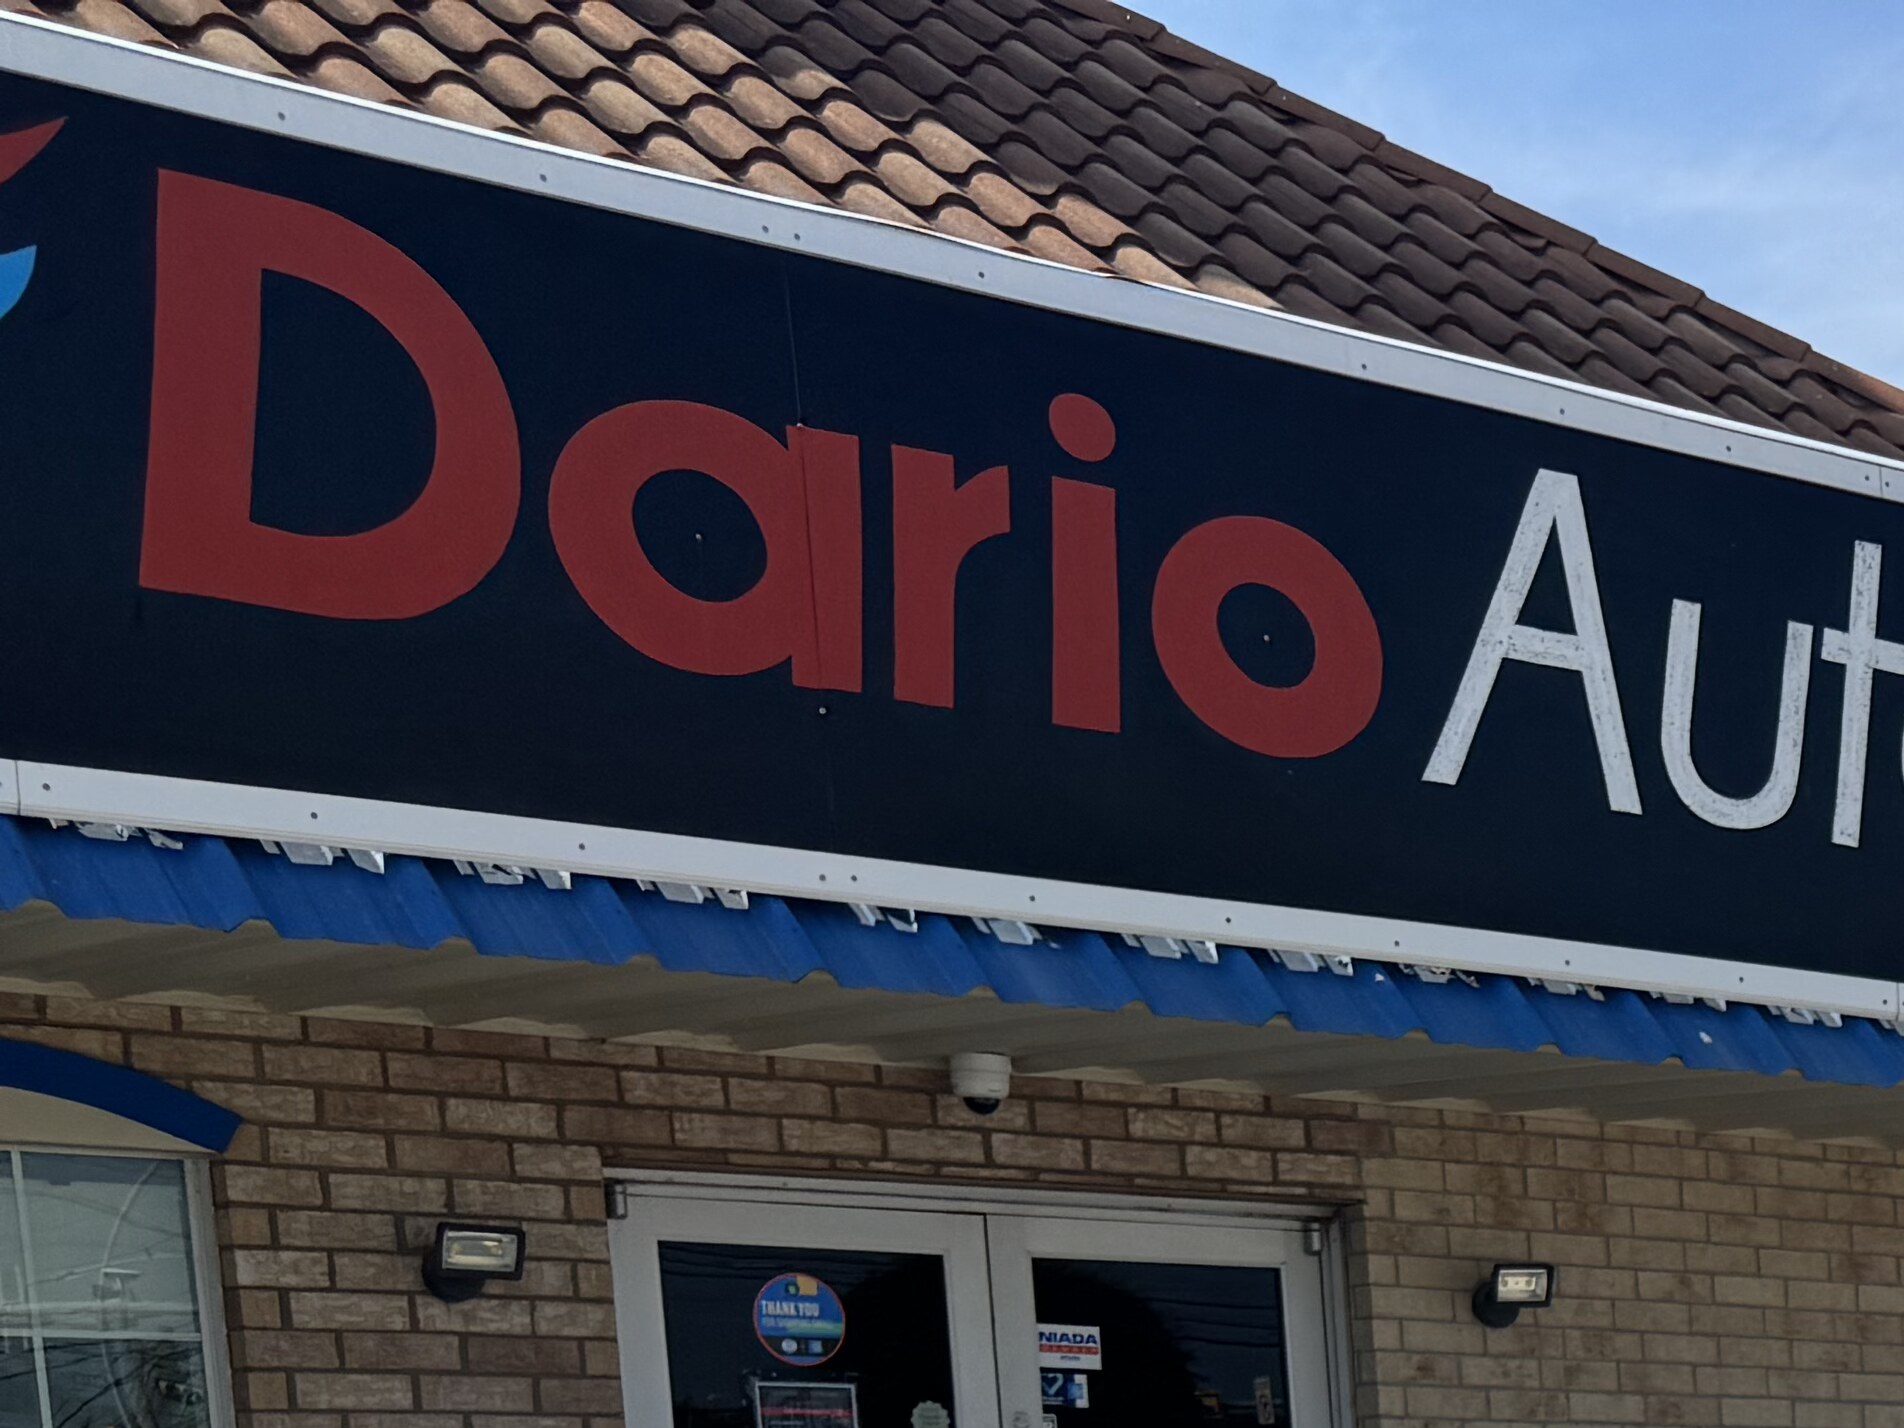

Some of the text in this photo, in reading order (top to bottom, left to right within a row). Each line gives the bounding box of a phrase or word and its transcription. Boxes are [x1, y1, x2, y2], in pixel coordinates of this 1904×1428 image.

[138, 168, 1384, 759] Dario
[761, 1300, 820, 1317] THANK YOU
[1038, 1331, 1098, 1345] NIADA
